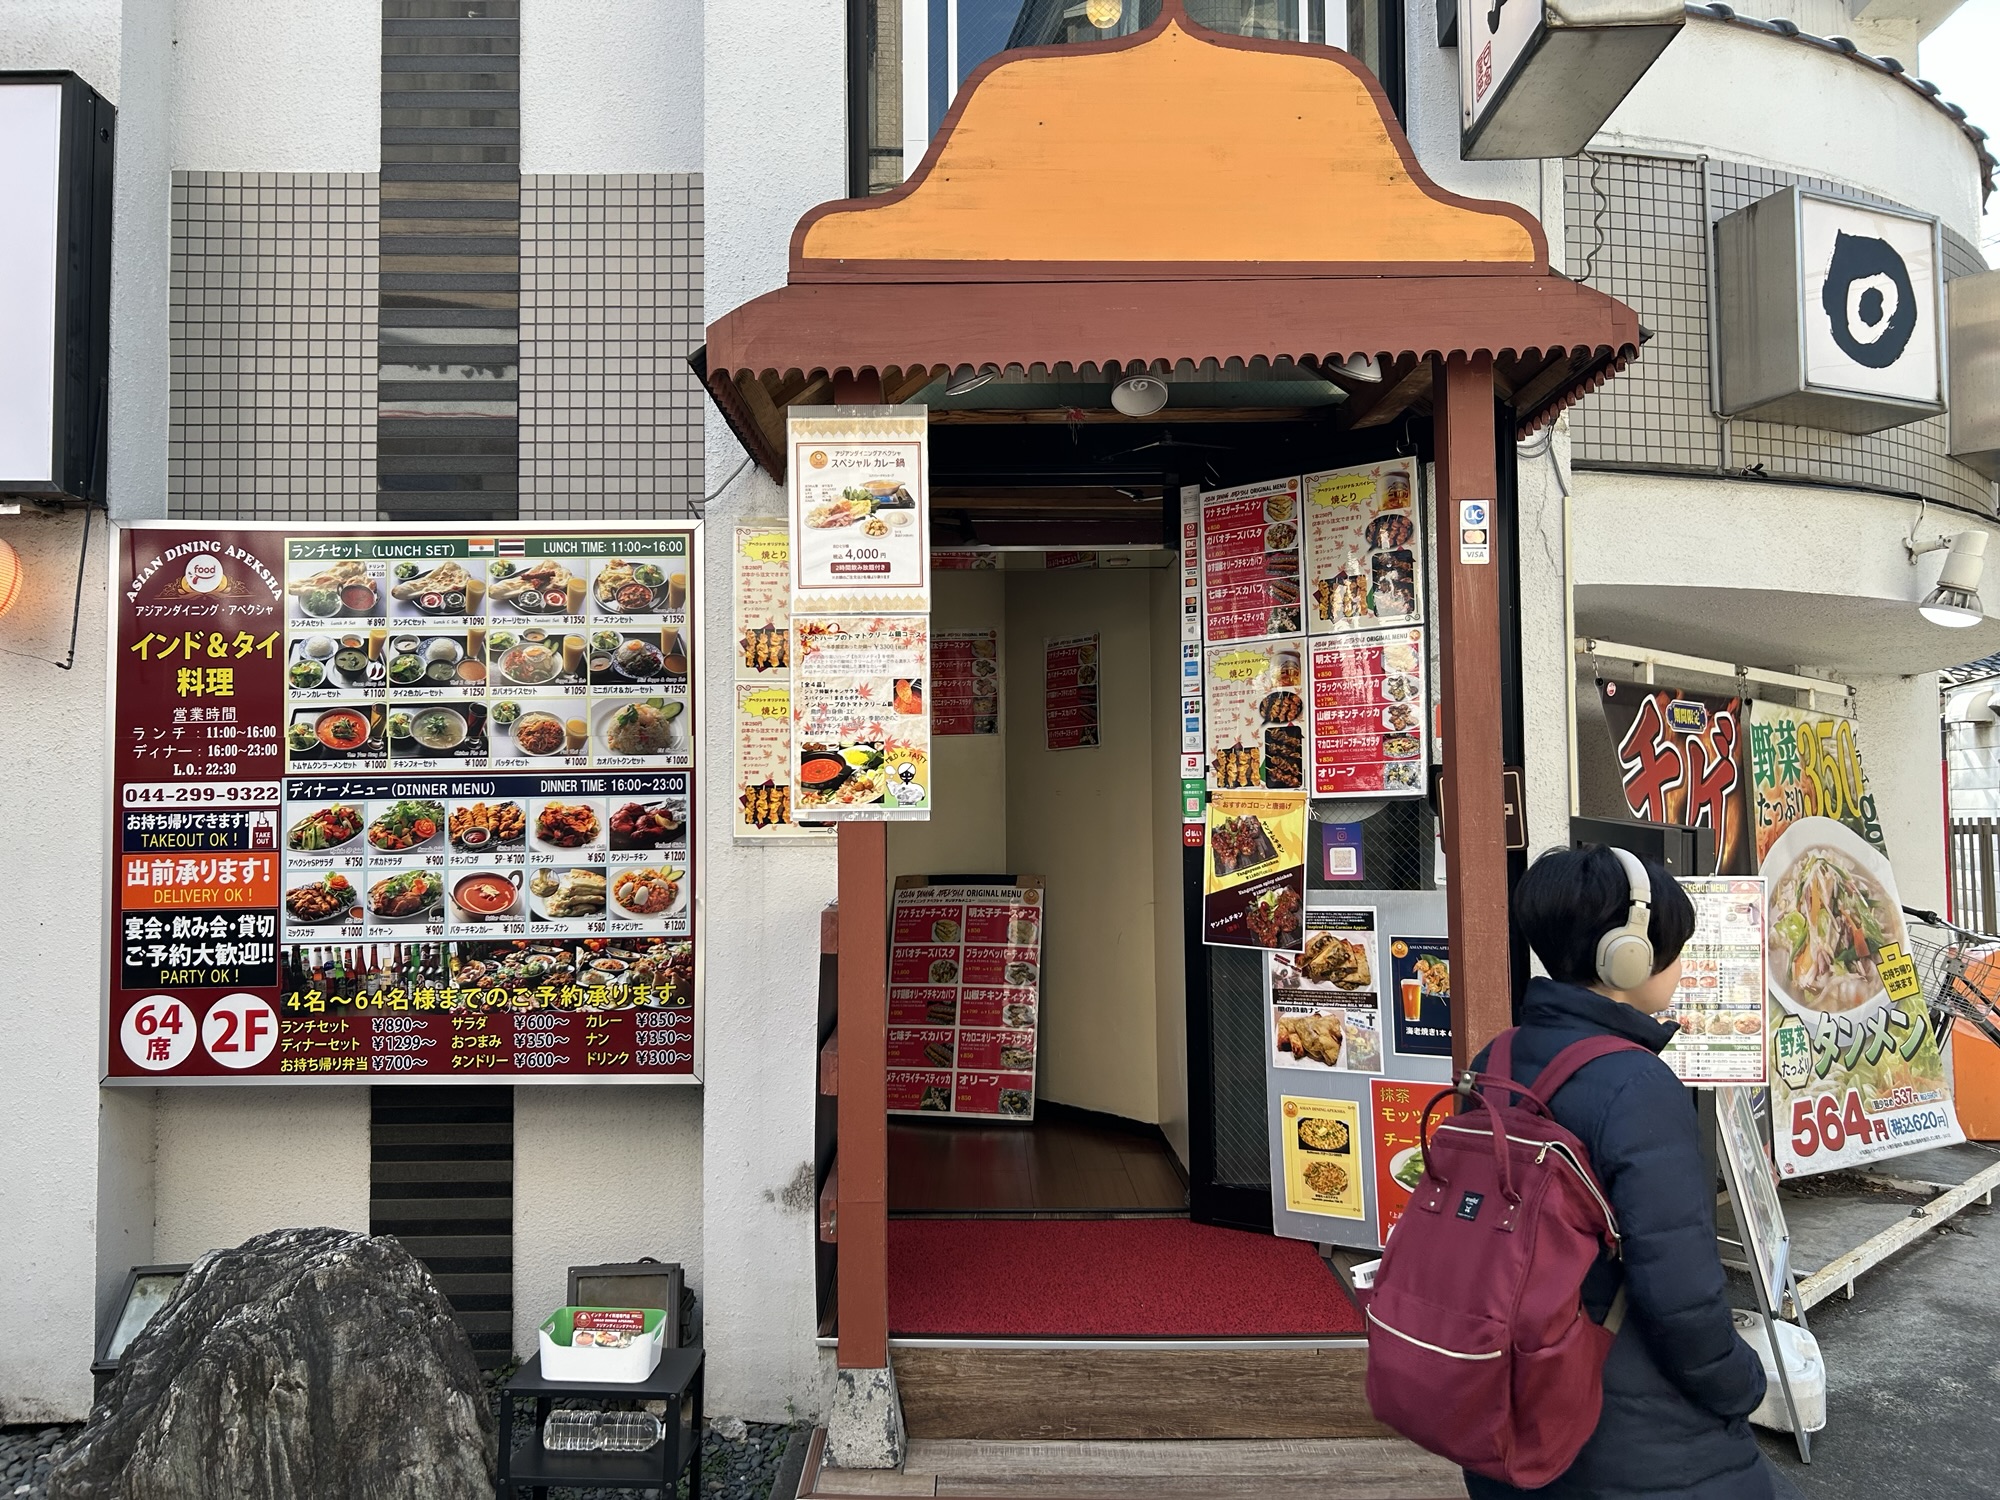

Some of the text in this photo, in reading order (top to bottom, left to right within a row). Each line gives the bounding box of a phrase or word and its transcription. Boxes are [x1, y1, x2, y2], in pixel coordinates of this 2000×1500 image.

[831, 458, 906, 468] スペシャル カレー鍋
[1250, 486, 1272, 494] ORIGINAL
[1331, 492, 1357, 505] 焼とり
[292, 543, 455, 558] ランチセット (LUNCH SET)
[543, 540, 683, 554] LUNCH TIME: 11:00~16:00
[761, 550, 787, 560] 焼とり
[845, 548, 879, 560] 4,000
[126, 540, 282, 603] ASIAN DINING APEKSHA
[194, 564, 216, 575] food
[136, 604, 274, 617] アジアンダイニング・アペクシャ
[291, 619, 325, 627] ランチAセット
[367, 618, 386, 627] ¥890
[393, 618, 427, 626] ランチCセット
[462, 617, 485, 626] ¥1090
[491, 616, 531, 624] タンドーリセット
[563, 615, 586, 624] ¥1350
[593, 616, 634, 624] チーズナンセット
[662, 615, 685, 623] ¥1350
[1366, 634, 1391, 643] ORIGINAL
[130, 630, 281, 660] インド&タイ
[1184, 644, 1200, 658] JCB
[1229, 668, 1252, 678] 焼とり
[177, 667, 234, 697] 料理
[291, 690, 341, 698] グリーンカレーセット
[363, 689, 386, 698] ¥1100
[393, 689, 443, 697] タイ2色カレーセット
[462, 688, 485, 696] ¥1250
[564, 686, 587, 695] ¥1050
[664, 685, 686, 694] ¥1250
[761, 706, 787, 715] 焼とり
[1184, 701, 1200, 714] JCB
[173, 707, 238, 722] 営業時間
[1673, 707, 1701, 725] 期間限定
[1751, 719, 1801, 788] 野菜
[292, 761, 357, 769] トムヤムクンラーメンセット
[364, 760, 387, 769] ¥1000
[393, 760, 438, 768] チキンフォーセット
[465, 759, 487, 768] ¥1000
[564, 757, 587, 766] ¥1000
[666, 756, 688, 764] ¥1000
[205, 762, 237, 776] 22:30
[1317, 766, 1356, 778] オリーブ
[290, 781, 495, 798] ディナーメニュー (DINNER MENU)
[541, 778, 683, 793] DINNER TIME: 16:00~23:00
[125, 786, 279, 802] 044-299-9322
[127, 813, 249, 830] お持ち帰りできます!
[1185, 829, 1202, 837] d払い
[141, 833, 204, 848] TAKEOUT
[256, 838, 269, 846] OUT
[425, 856, 444, 865] ¥900
[531, 855, 554, 863] チキンチリ
[587, 853, 606, 862] ¥850
[611, 853, 648, 861] タンドリーチキン
[664, 851, 685, 861] ¥1200
[345, 857, 363, 867] ¥750
[127, 858, 270, 887] 出前承ります!
[1710, 882, 1728, 892] MENU
[153, 888, 219, 904] DELIVERY
[966, 889, 1022, 898] ORIGINAL MENU
[911, 907, 960, 918] チェダーチーズ ナン
[125, 914, 275, 940] 宴会・飲み会・貸切
[425, 925, 444, 935] ¥900
[450, 926, 493, 934] バターチキンカレー
[503, 924, 525, 934] ¥1050
[587, 922, 606, 932] ¥580
[664, 921, 685, 931] ¥1200
[288, 929, 315, 937] ミックスサテ
[341, 927, 363, 937] ¥1000
[369, 928, 393, 936] ガイヤーン
[125, 941, 275, 968] ご予約大歓迎!!
[160, 969, 205, 985] PARTY
[1882, 963, 1912, 981] お持ち帰り
[1888, 977, 1913, 993] 出来ます
[287, 983, 686, 1013] 4名～64名様までのご予約承ります。
[281, 1019, 349, 1033] ランチセット
[452, 1016, 488, 1030] サラダ
[585, 1014, 623, 1028] カレー
[134, 1003, 270, 1053] 64 2F
[281, 1038, 360, 1052] ディナーセット
[452, 1034, 502, 1049] おつまみ
[585, 1033, 610, 1046] ナン
[1778, 1024, 1809, 1058] 野菜
[1815, 1007, 1927, 1080] タンメン
[146, 1036, 171, 1062] 席
[281, 1056, 368, 1072] お持ち帰り弁当
[452, 1055, 508, 1070] タンドリー
[587, 1051, 629, 1066] ドリンク
[1781, 1059, 1810, 1080] たっぷり
[959, 1074, 1000, 1086] オリーブ
[1380, 1087, 1410, 1104] 抹茶
